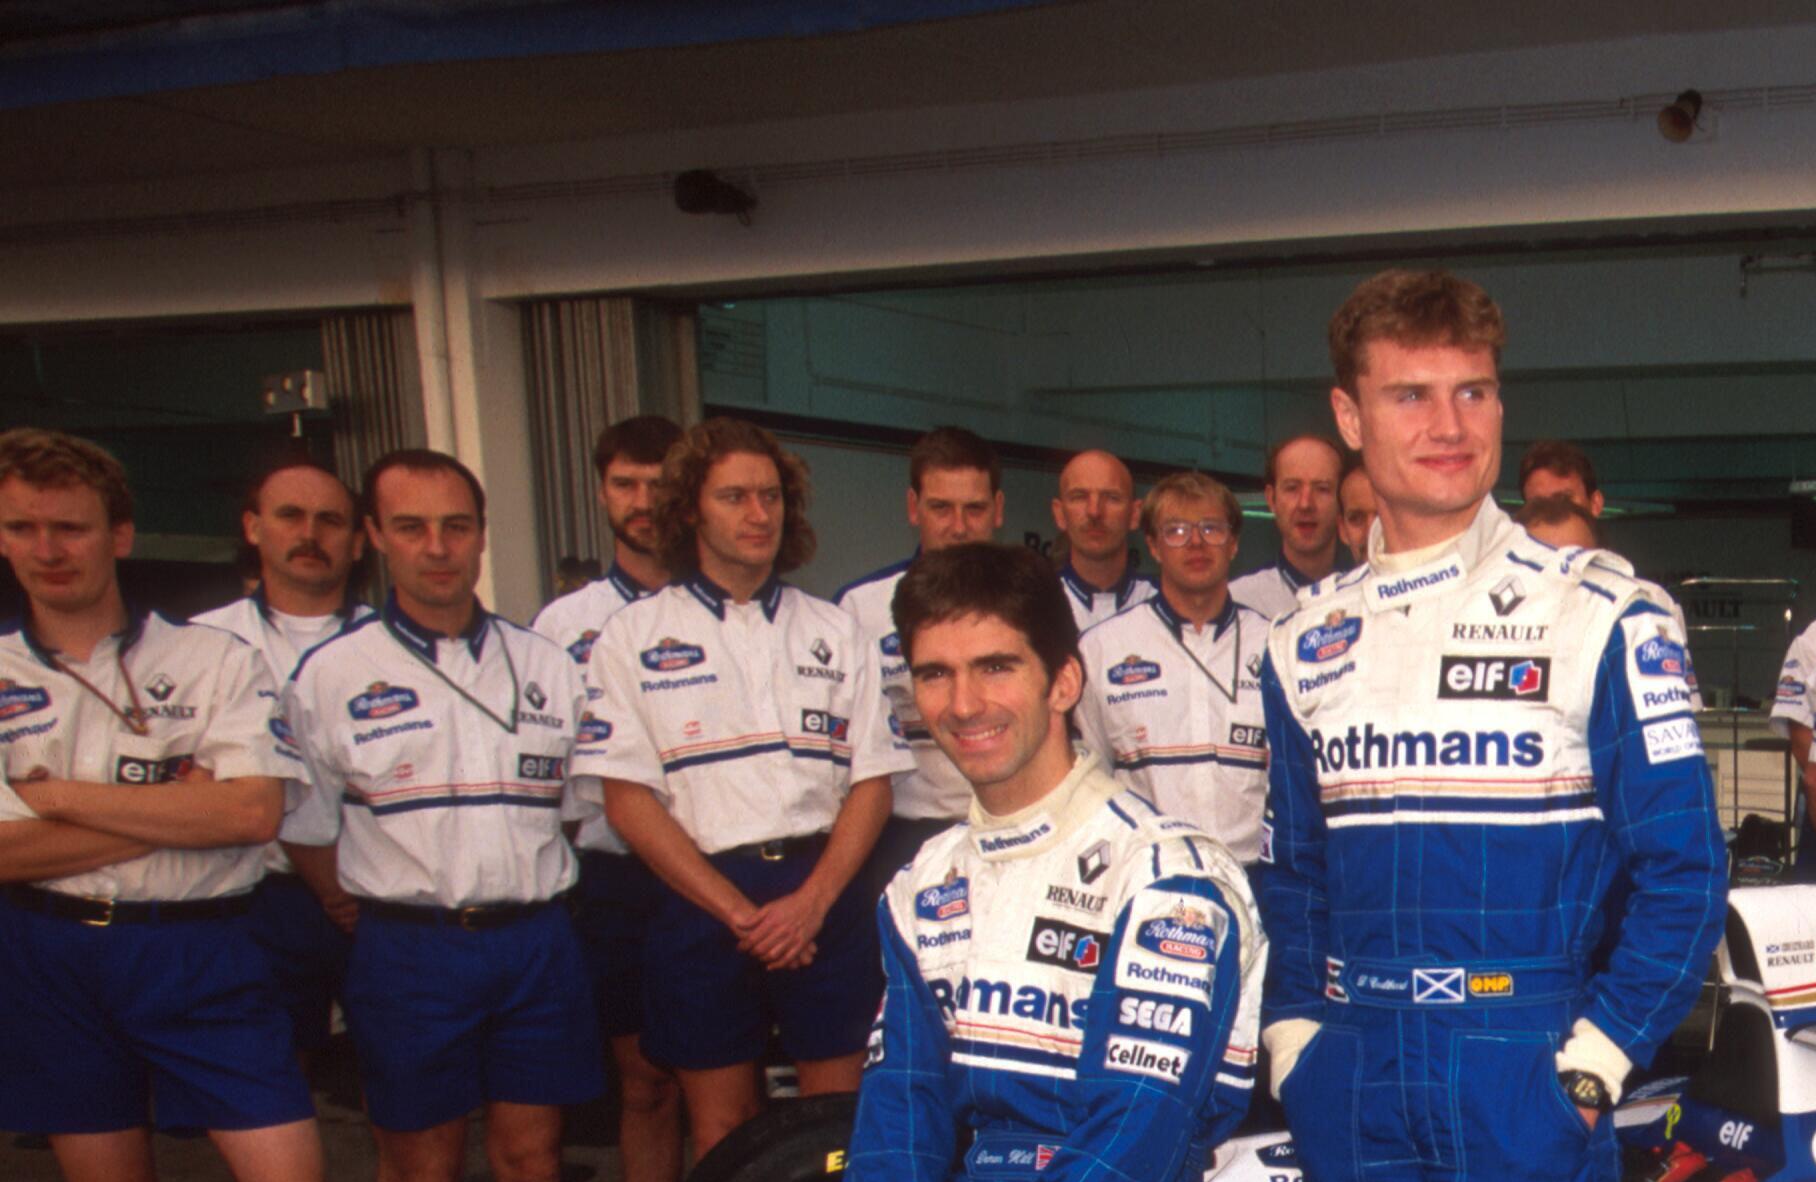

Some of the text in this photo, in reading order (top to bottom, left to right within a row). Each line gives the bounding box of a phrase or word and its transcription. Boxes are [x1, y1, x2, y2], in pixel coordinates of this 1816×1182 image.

[1378, 564, 1460, 599] Rothmans
[1452, 622, 1551, 642] RENAULT
[641, 672, 719, 693] Rothmans
[1446, 660, 1506, 693] elf
[1107, 687, 1168, 705] Rothmans
[354, 719, 434, 746] Rothmans
[1231, 726, 1264, 745] elf
[1308, 722, 1545, 775] Rothmans
[1035, 927, 1077, 962] elf
[1766, 952, 1816, 969] RENAULT
[1127, 962, 1212, 993] Rothman
[1470, 976, 1512, 994] OMP
[1118, 998, 1192, 1037] SEGA
[1718, 1119, 1755, 1151] elf
